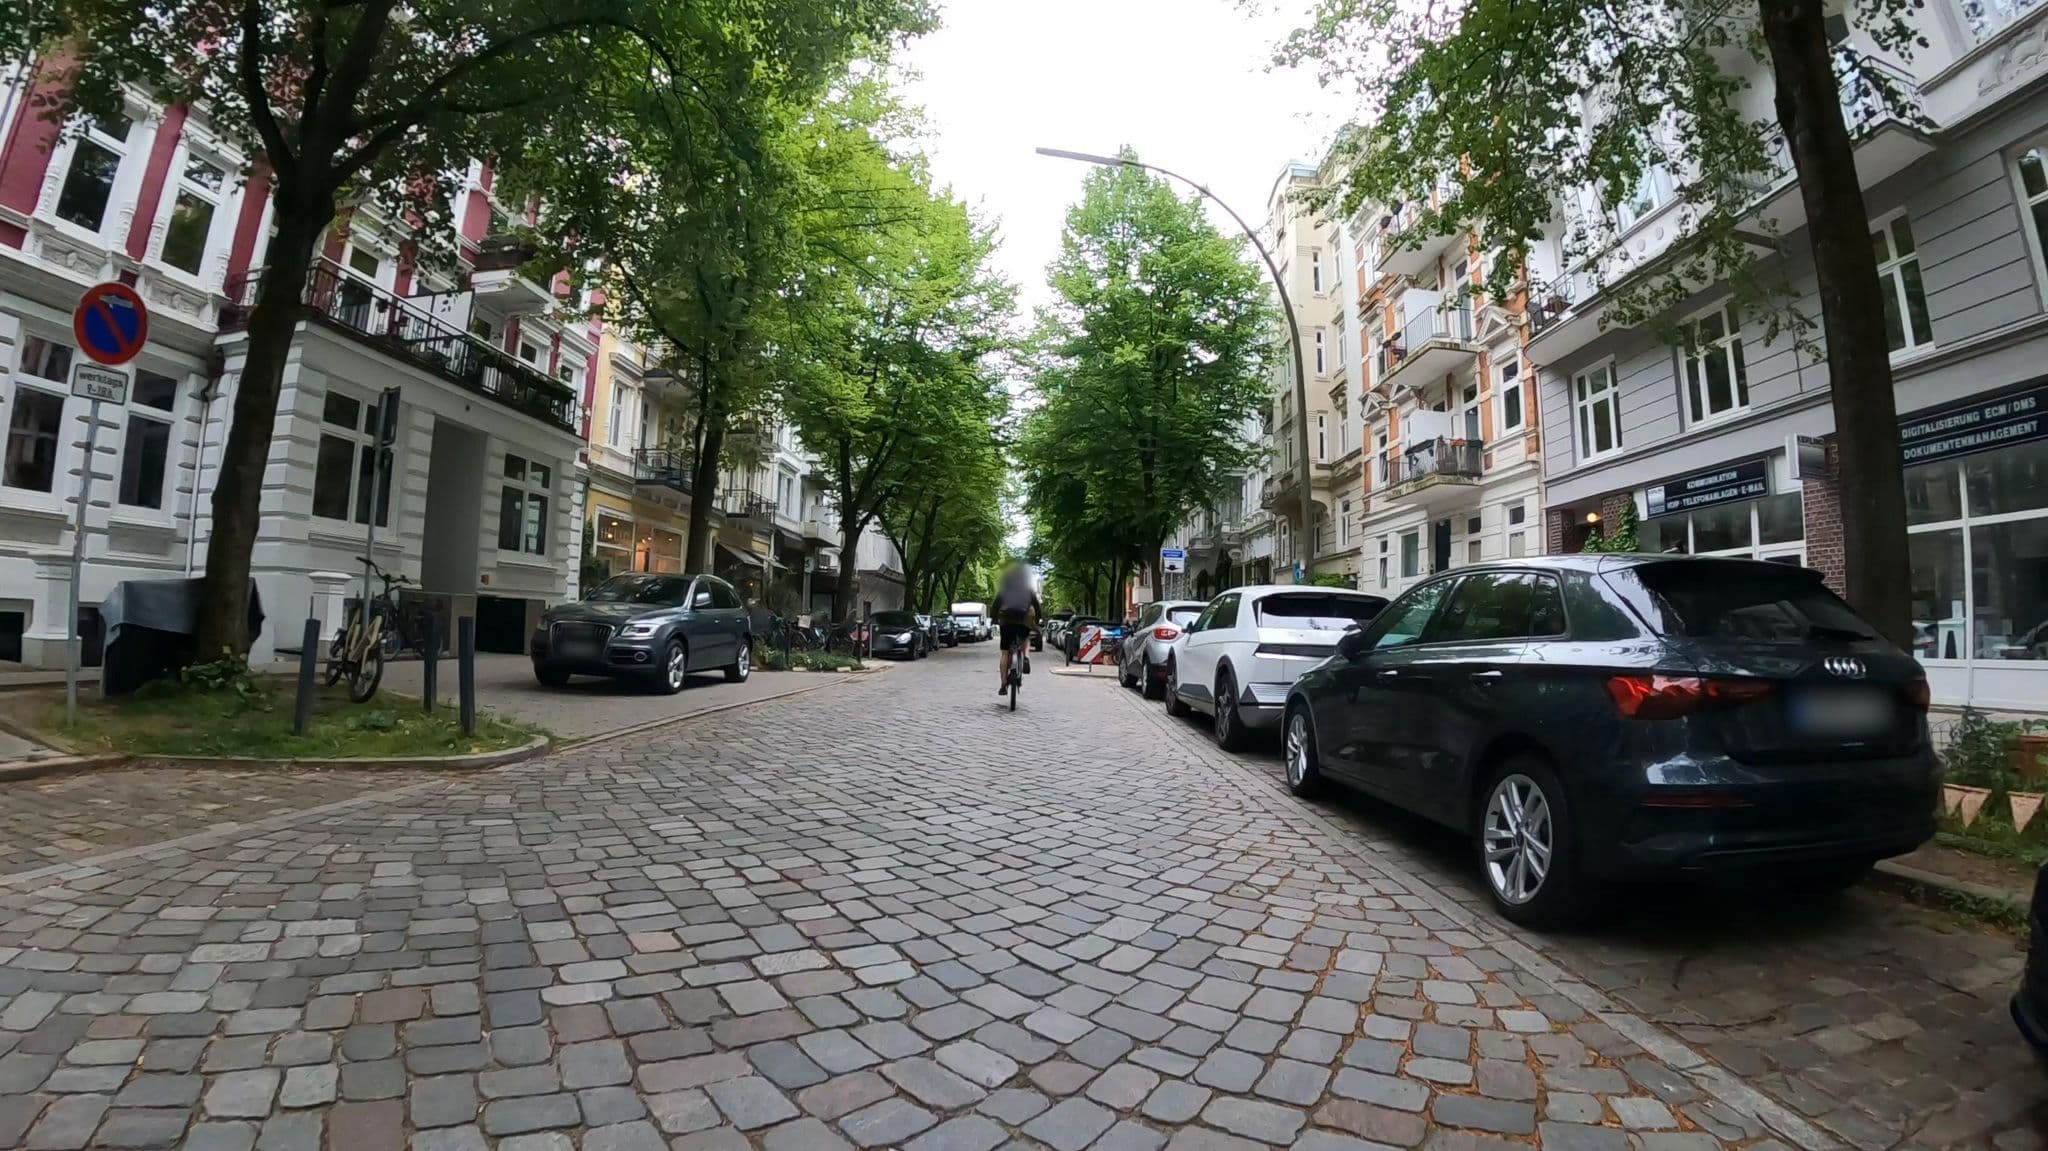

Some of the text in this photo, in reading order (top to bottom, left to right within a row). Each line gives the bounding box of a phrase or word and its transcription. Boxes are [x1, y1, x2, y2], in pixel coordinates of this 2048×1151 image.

[79, 372, 123, 389] werktags
[1902, 411, 1980, 439] DIGITALISIERUNG
[1903, 420, 2038, 460] DOKUMENTENMANAGEMENT
